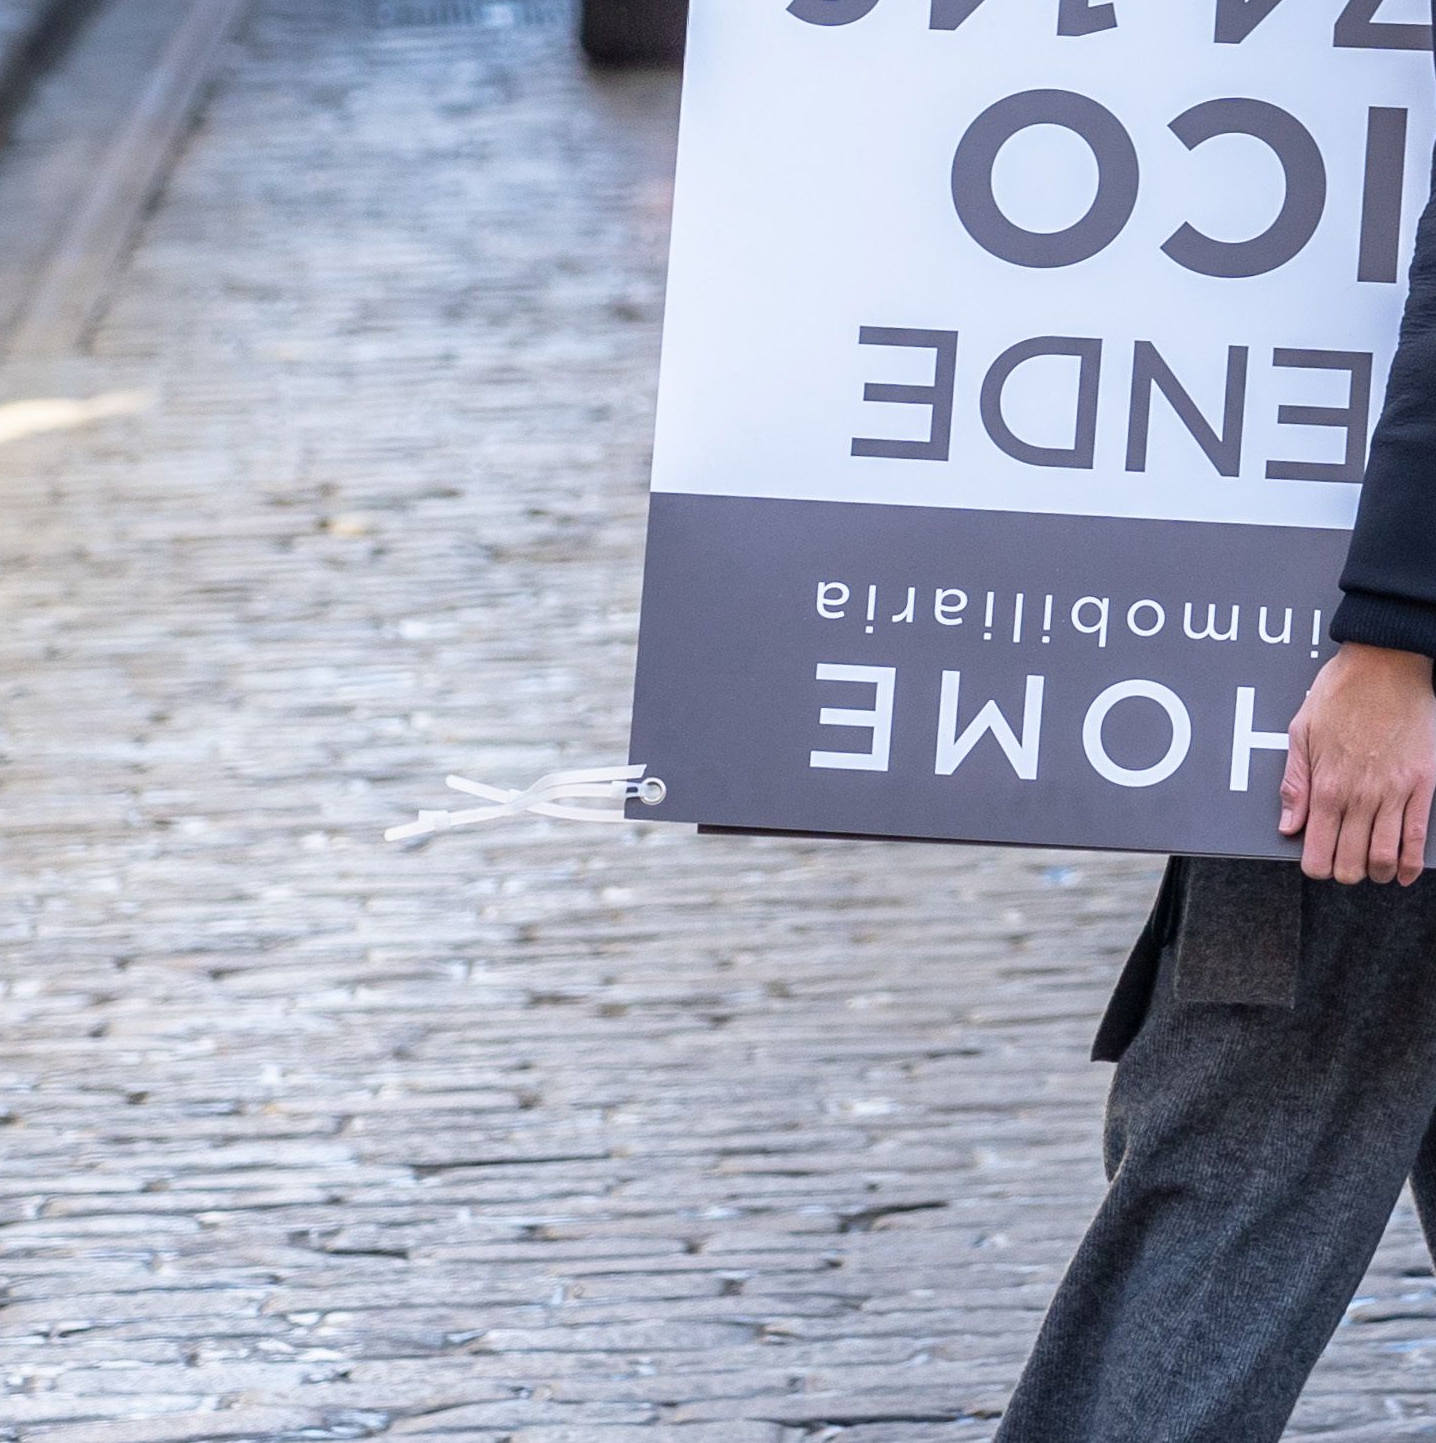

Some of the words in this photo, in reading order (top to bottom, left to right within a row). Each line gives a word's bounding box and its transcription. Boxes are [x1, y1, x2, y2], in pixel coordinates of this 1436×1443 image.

[849, 325, 1374, 485] ENDE
[815, 580, 1324, 659] inmobiliaria
[808, 661, 1312, 793] HOME
